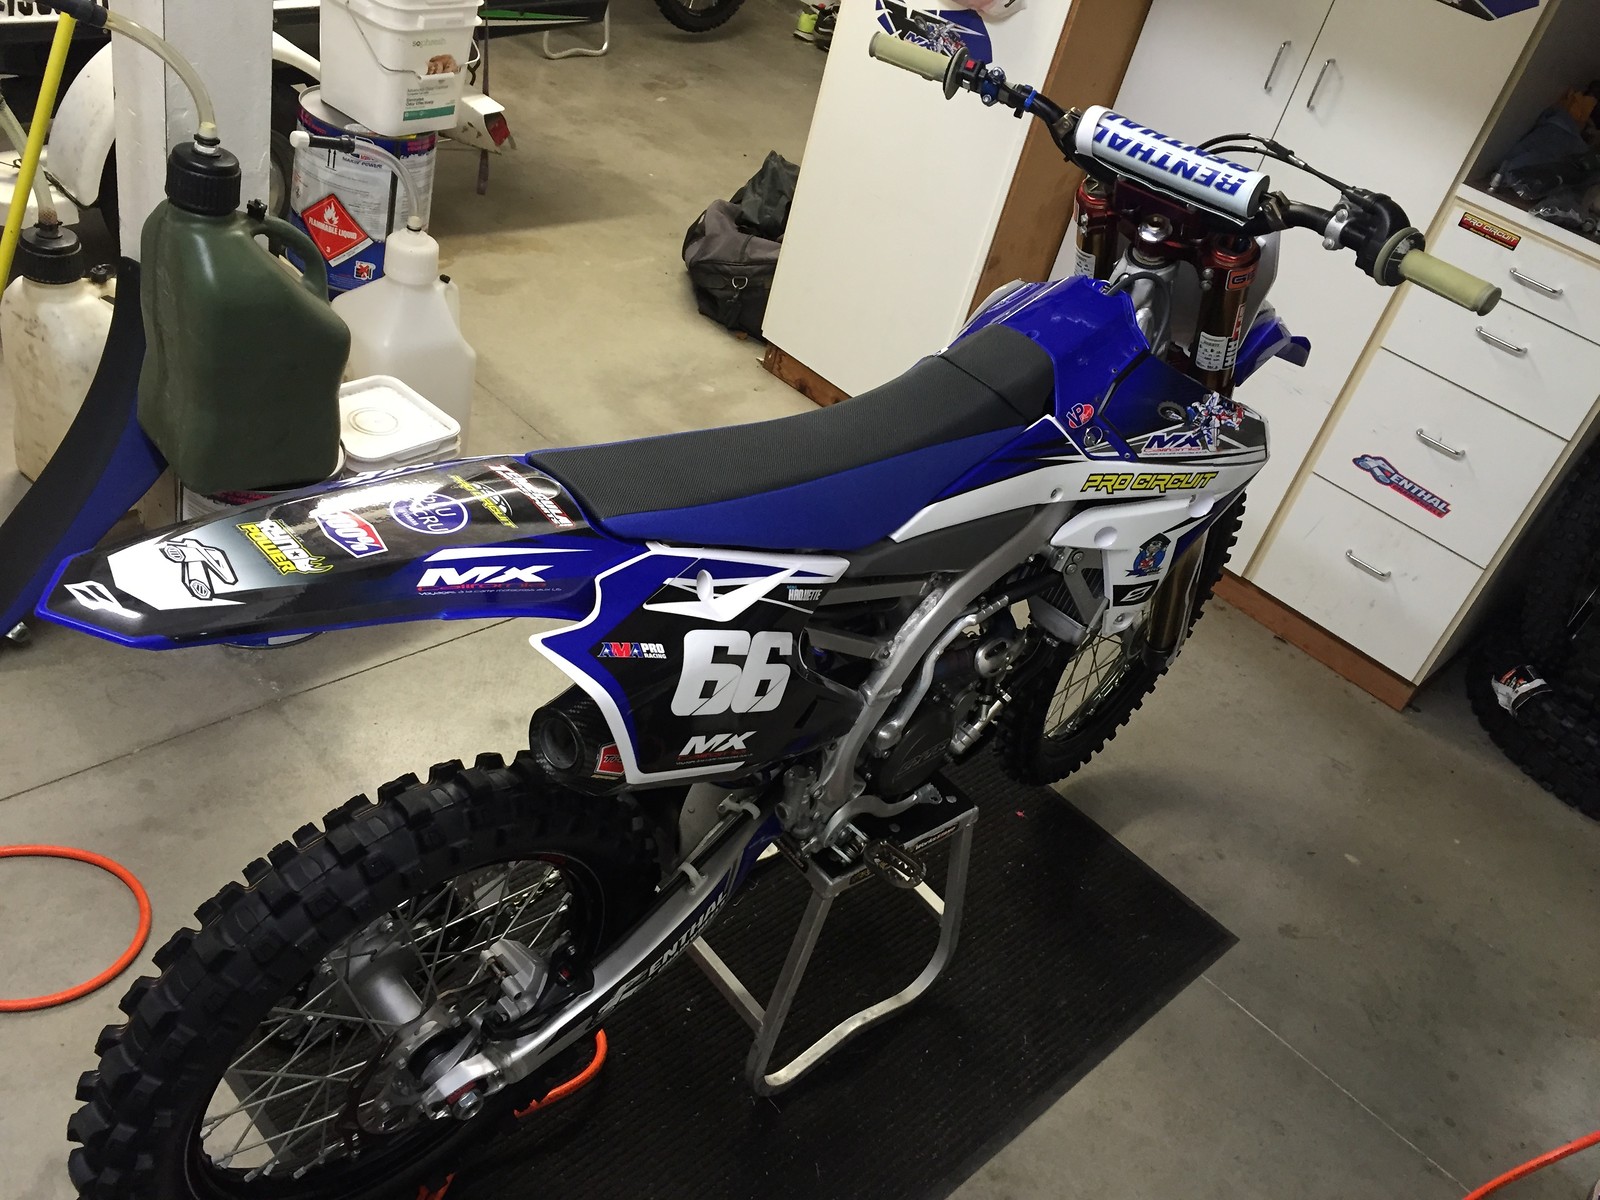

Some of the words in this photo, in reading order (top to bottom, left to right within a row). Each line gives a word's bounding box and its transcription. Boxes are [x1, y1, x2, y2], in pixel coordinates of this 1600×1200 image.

[1093, 123, 1247, 196] RENTHAL
[308, 216, 338, 235] FLAMMABLE
[338, 229, 357, 240] LIQUID
[1464, 216, 1483, 228] PRO
[1483, 225, 1518, 242] CIRCUIT
[1066, 403, 1084, 427] VP
[1144, 433, 1205, 449] MX
[1080, 473, 1133, 494] PRO
[1131, 471, 1219, 493] CIRCUIT
[470, 490, 518, 529] CRCUIT
[239, 523, 298, 573] POWER
[416, 565, 554, 587] MX
[597, 642, 643, 658] AMA
[640, 642, 665, 654] PRO
[644, 652, 667, 660] RACING
[671, 629, 793, 717] 66
[678, 731, 757, 756] MX
